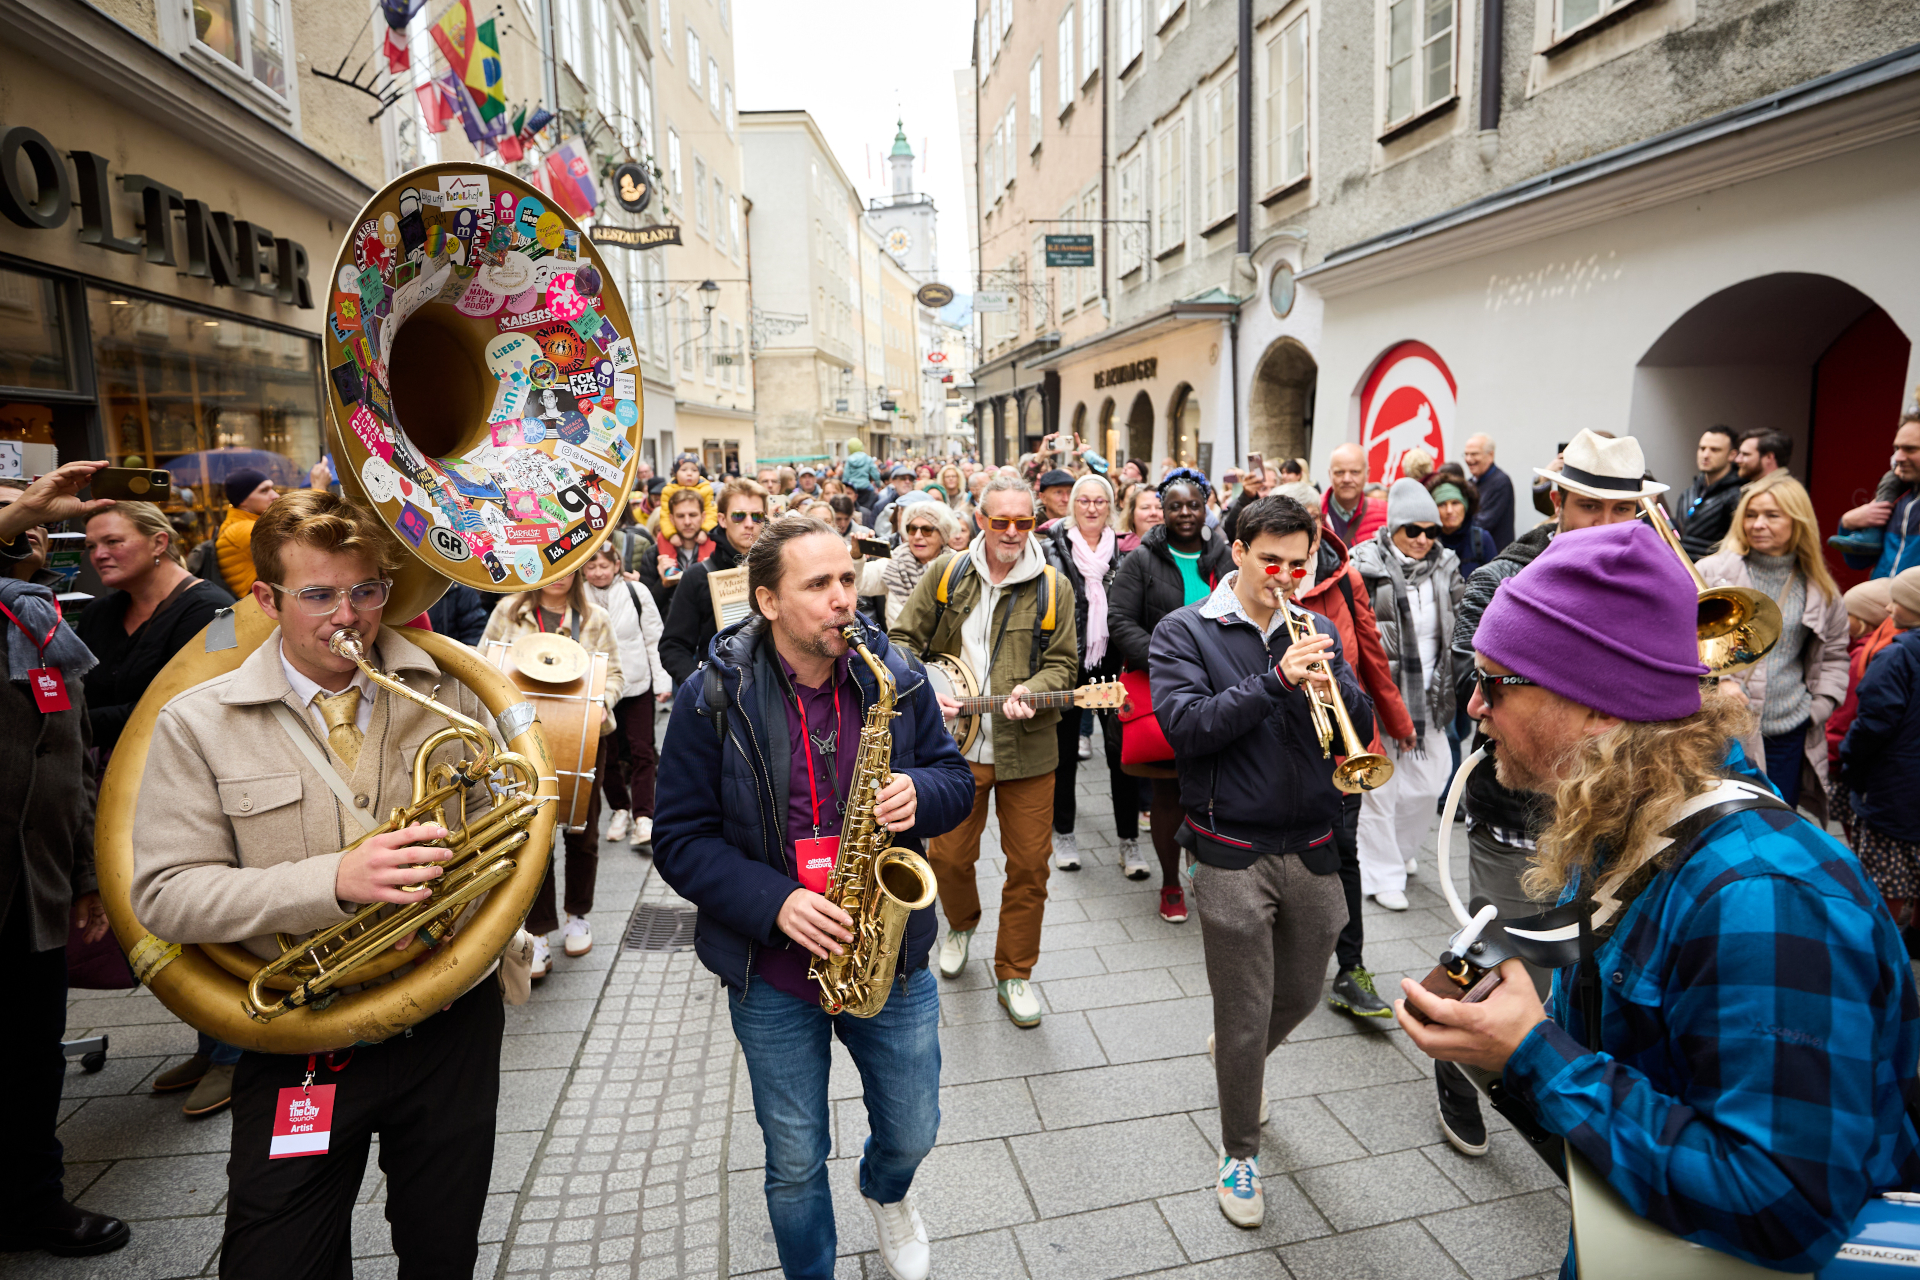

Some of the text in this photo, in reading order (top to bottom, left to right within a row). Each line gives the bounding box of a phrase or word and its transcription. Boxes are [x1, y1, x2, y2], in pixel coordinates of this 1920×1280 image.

[0, 126, 314, 310] OLTNER
[592, 227, 677, 245] RESTAURANT
[568, 373, 595, 386] FCK
[572, 382, 599, 398] NZS
[437, 531, 462, 555] GR
[548, 528, 588, 560] Ich dich
[723, 578, 747, 588] Music
[718, 585, 750, 598] Washbo
[290, 1098, 311, 1108] Jazz &
[289, 1106, 320, 1117] The City
[290, 1123, 314, 1133] Artist
